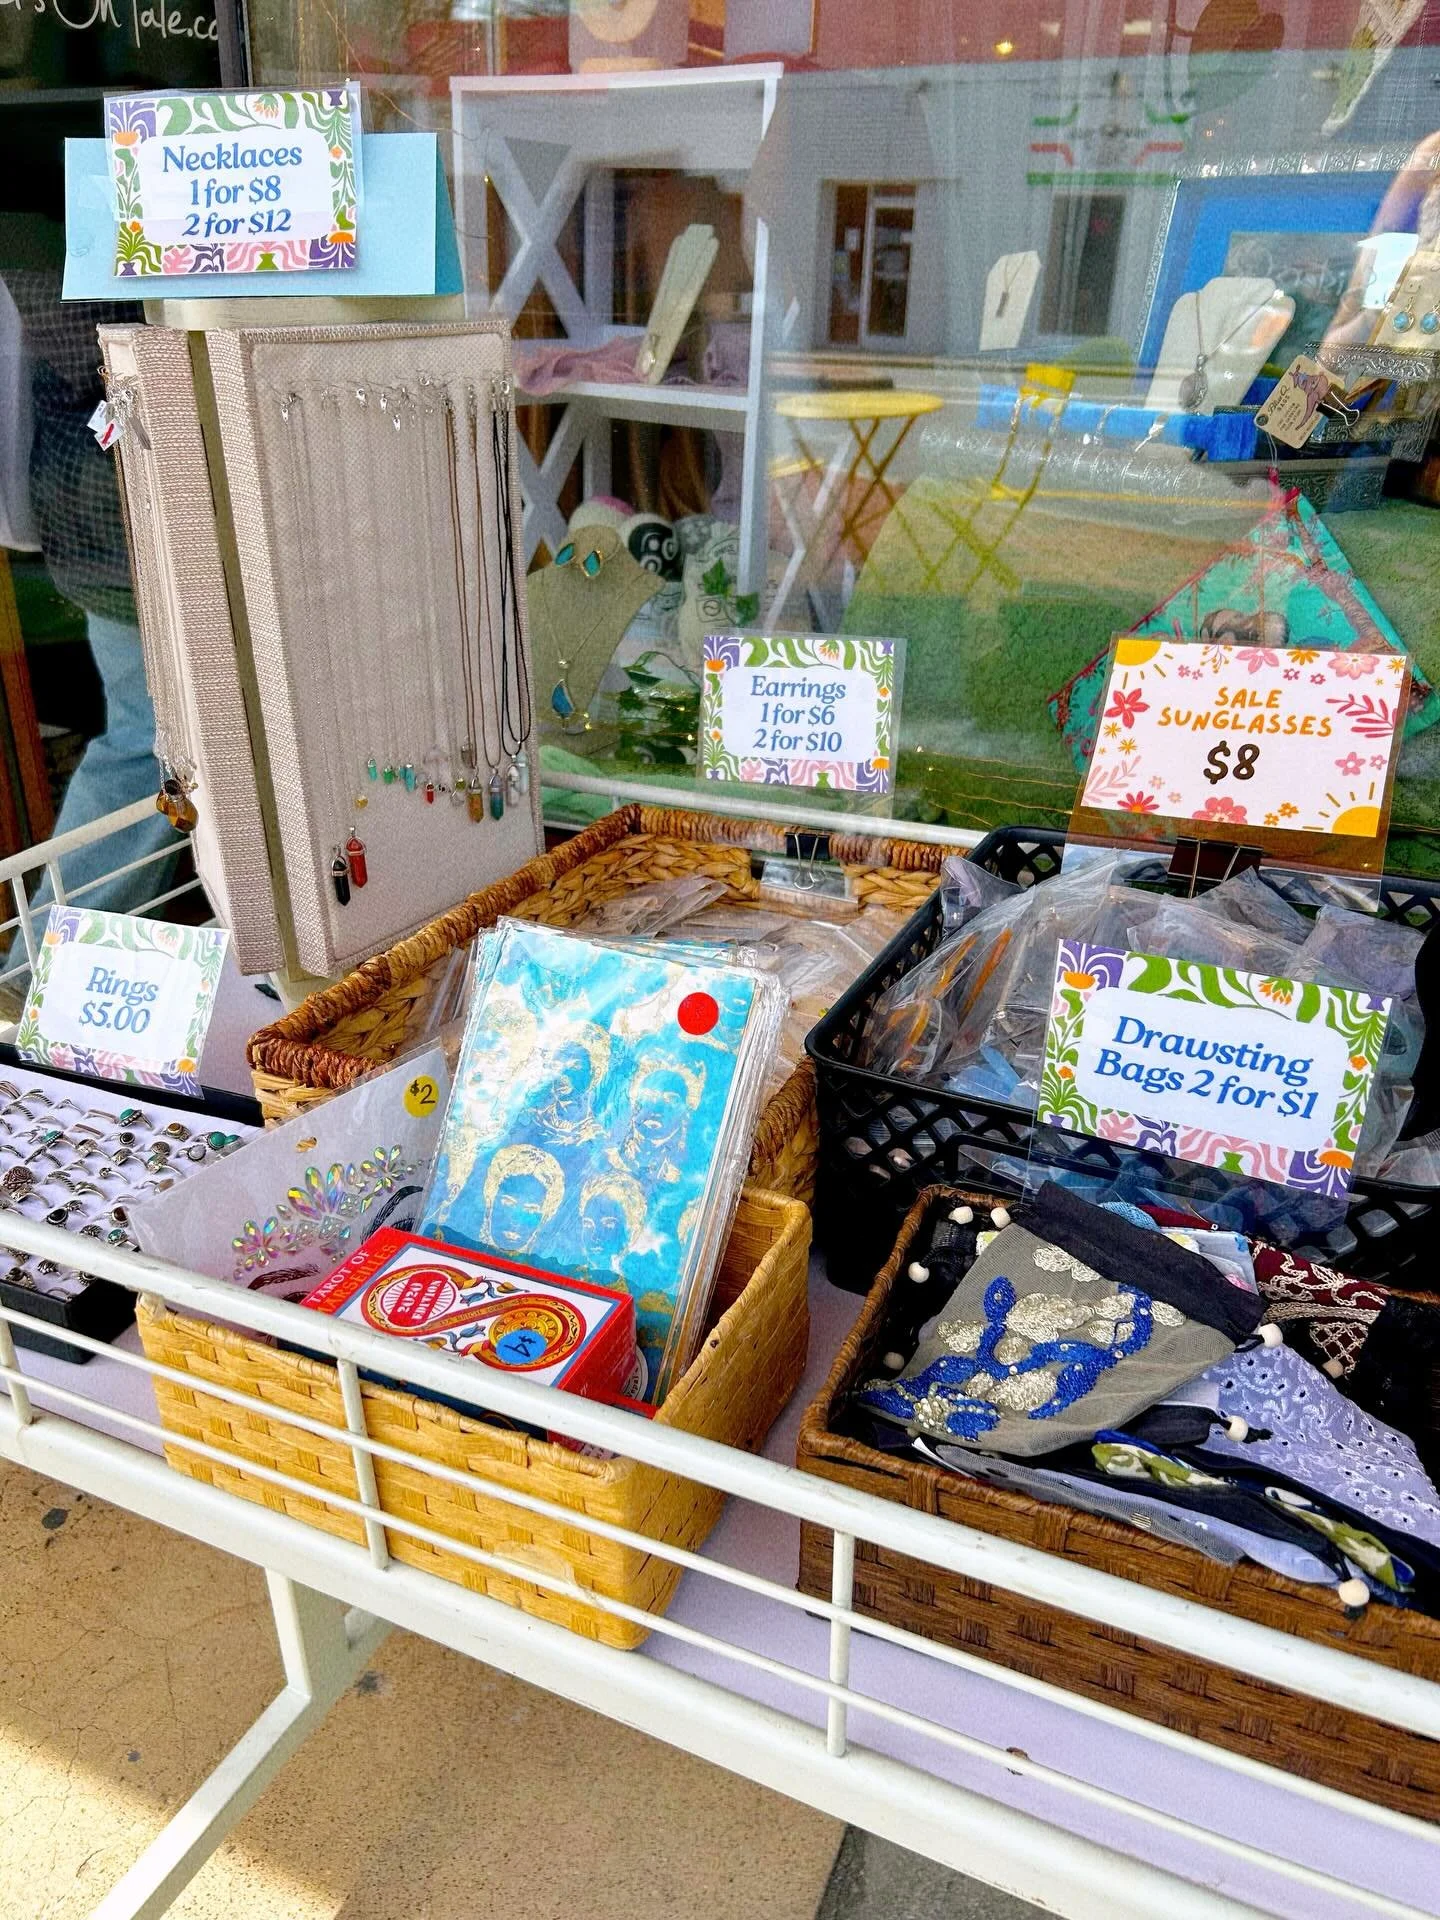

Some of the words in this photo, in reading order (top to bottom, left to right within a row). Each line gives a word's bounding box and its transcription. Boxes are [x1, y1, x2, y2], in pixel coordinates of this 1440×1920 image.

[162, 142, 303, 173] Necklaces
[190, 178, 200, 206] 1
[204, 177, 245, 209] for
[248, 174, 282, 205] $8
[181, 212, 200, 237] 2
[204, 211, 246, 238] for
[247, 208, 292, 236] $12
[750, 675, 847, 704] Earrings
[1214, 686, 1283, 709] SALE
[760, 702, 769, 723] 1
[772, 702, 806, 726] for
[807, 704, 836, 727] $6
[1157, 706, 1333, 738] SUNGLASSES
[752, 728, 768, 749] 2
[770, 729, 804, 752] for
[805, 731, 843, 753] $10
[1203, 740, 1260, 785] $8
[85, 966, 159, 1006] Rings
[78, 1000, 151, 1034] $5.00
[1112, 1015, 1315, 1087] Drawsting
[410, 1079, 436, 1105] $2
[1093, 1048, 1185, 1094] Bags
[1187, 1069, 1215, 1097] 2
[1216, 1075, 1276, 1108] for
[1277, 1089, 1319, 1119] $1
[307, 1266, 352, 1303] TAROT
[351, 1249, 370, 1265] OF
[397, 1282, 424, 1313] 2020
[411, 1280, 443, 1320] EDITION
